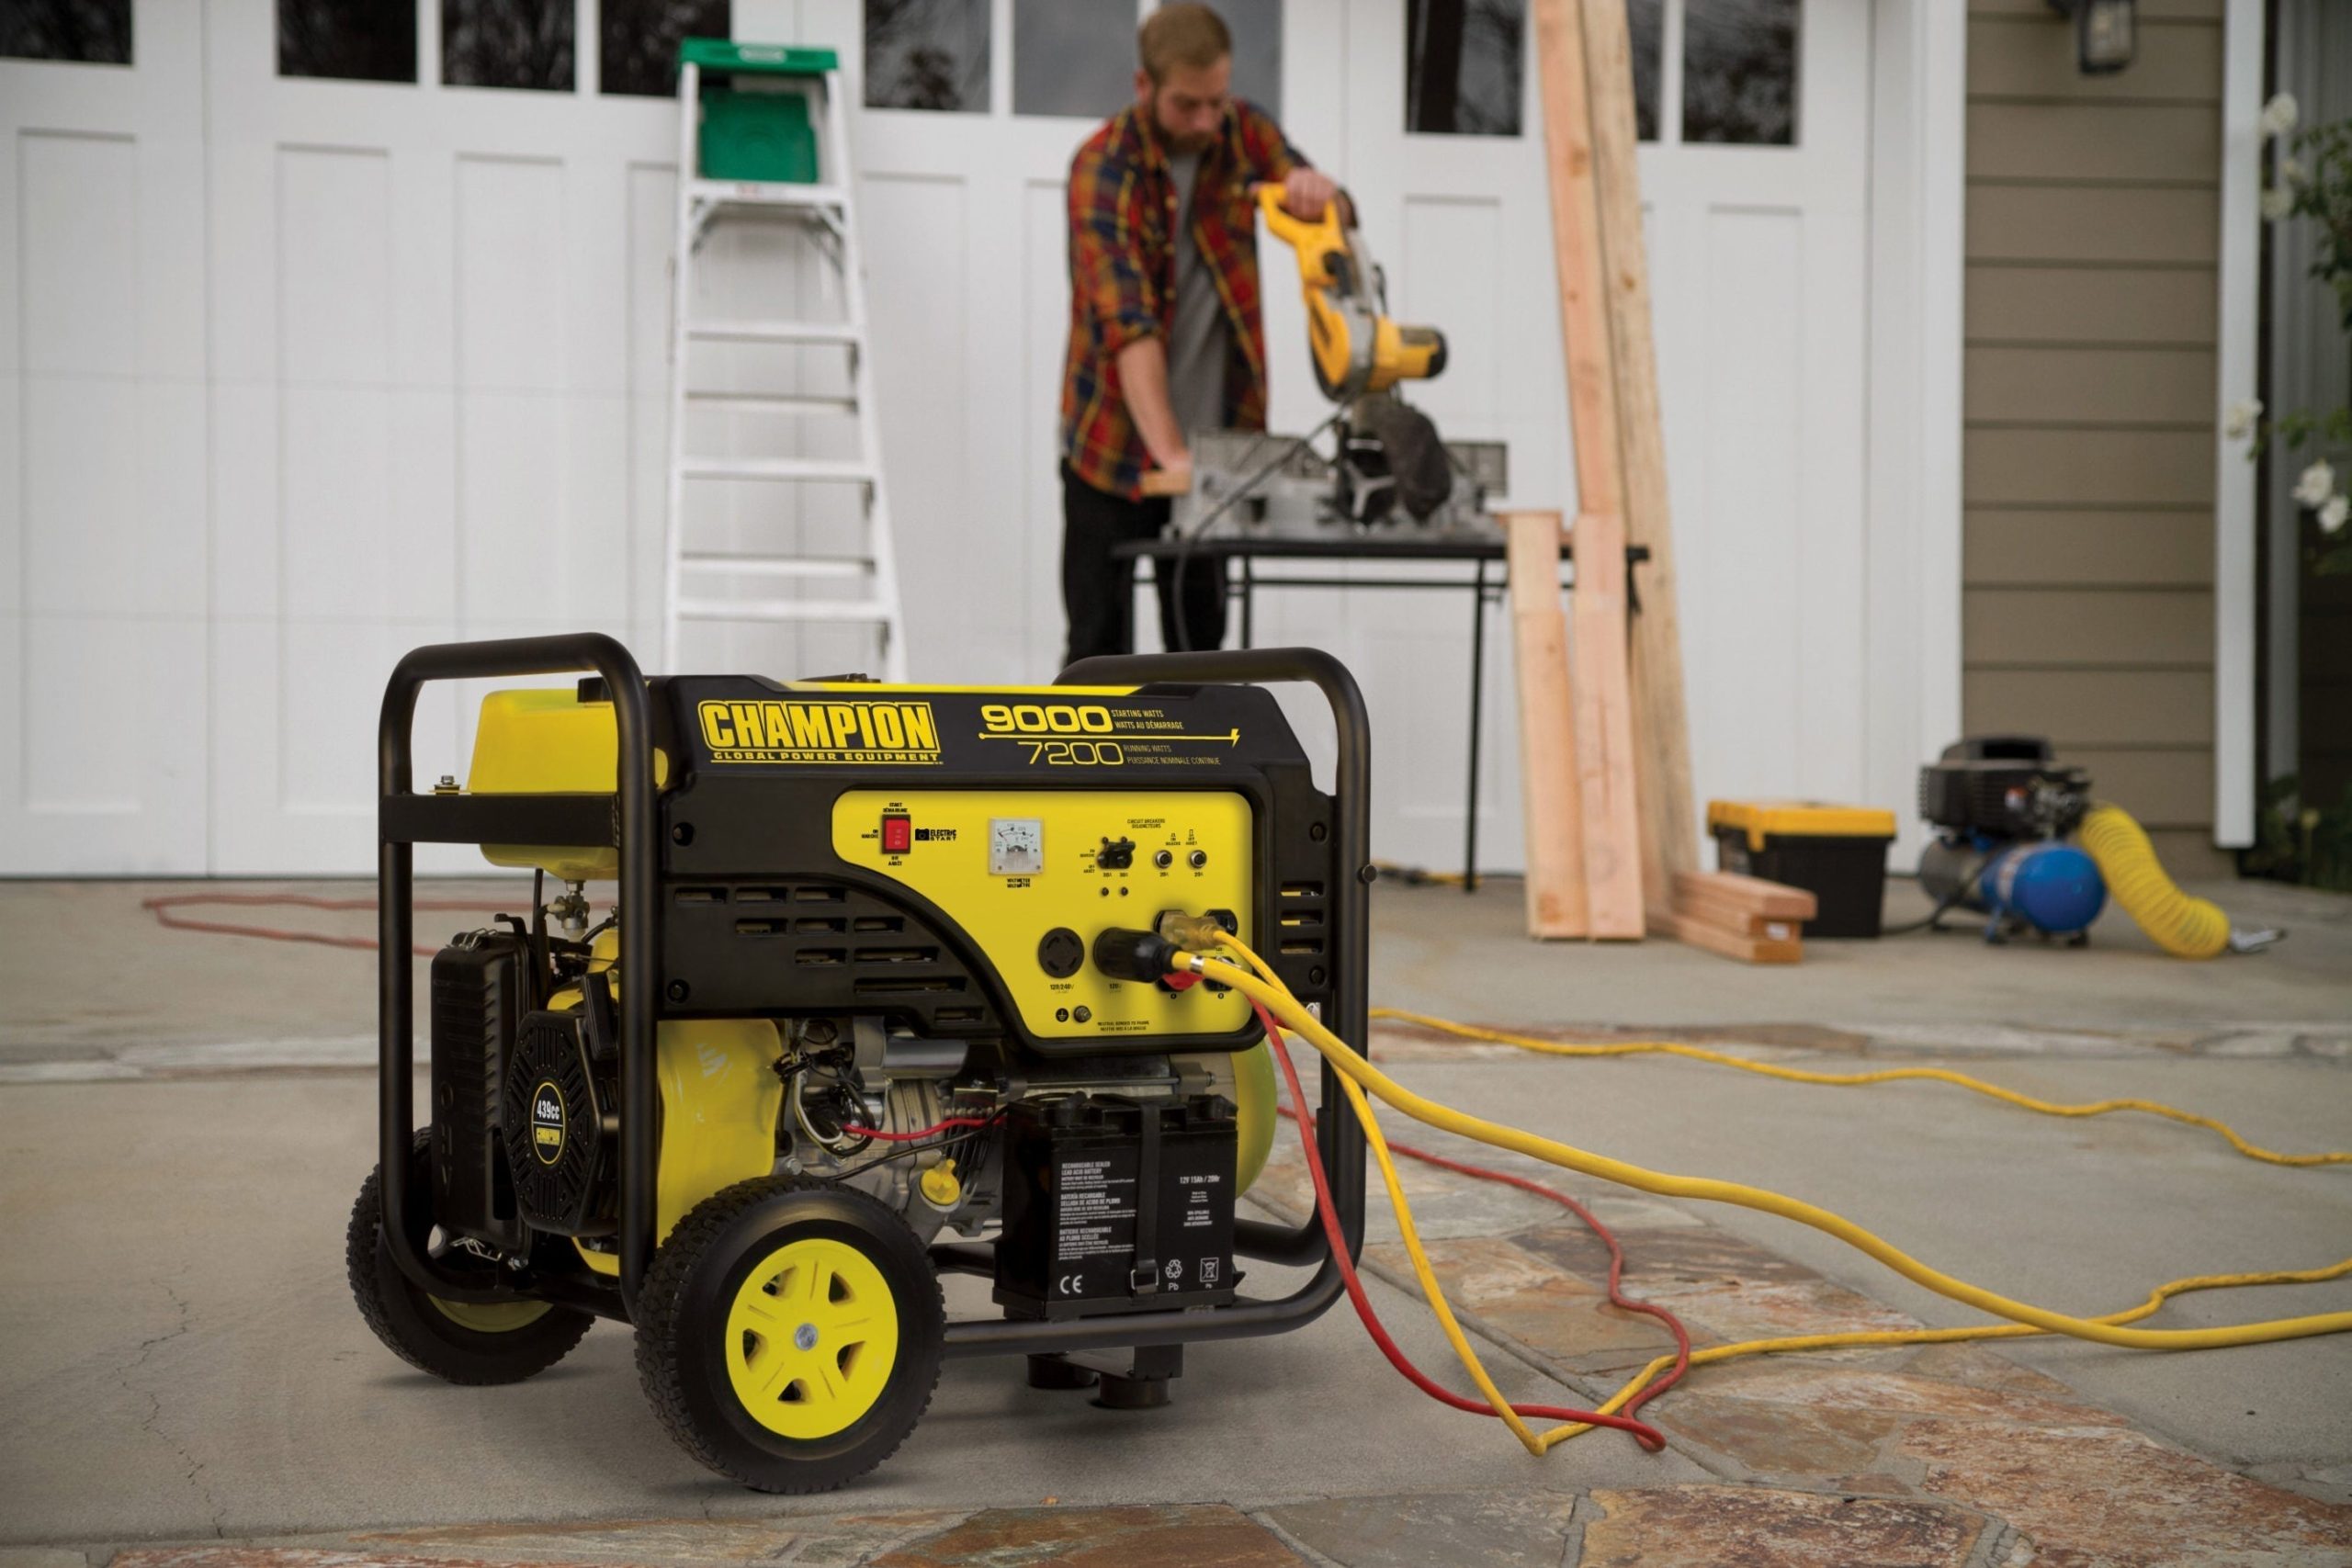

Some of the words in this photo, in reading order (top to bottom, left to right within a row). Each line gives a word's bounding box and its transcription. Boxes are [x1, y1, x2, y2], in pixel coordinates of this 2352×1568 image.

[1111, 709, 1142, 717] STARTING
[1143, 709, 1164, 717] WATTS
[981, 705, 1114, 732] 9000
[698, 700, 940, 751] CHAMPION
[1136, 721, 1145, 729] AU
[713, 752, 775, 761] GLOBAL
[781, 752, 837, 761] POWER
[845, 752, 937, 761] EQUIPMENT
[1017, 741, 1124, 765] 7200
[537, 1100, 560, 1121] 439cc
[1179, 1176, 1191, 1184] 12V
[1168, 1282, 1179, 1291] Pb
